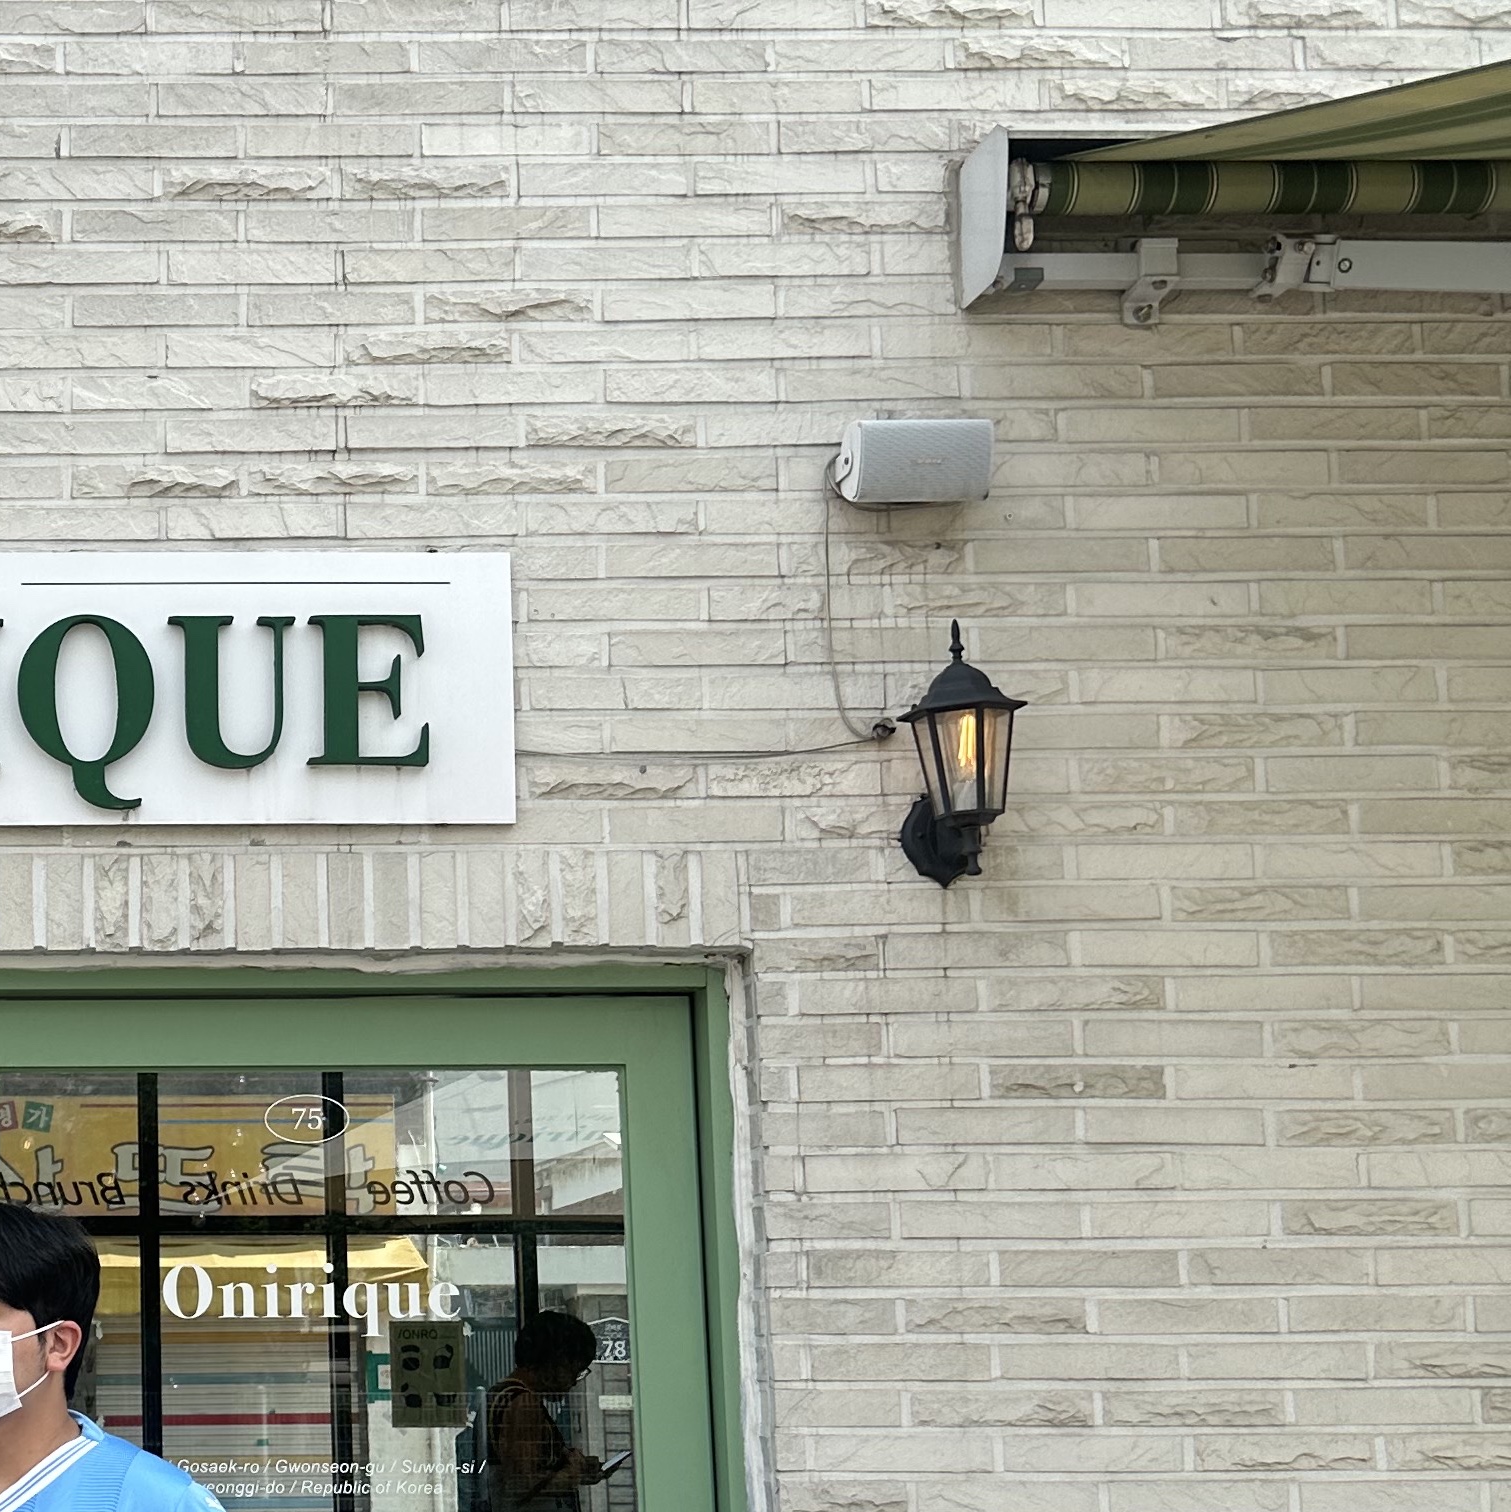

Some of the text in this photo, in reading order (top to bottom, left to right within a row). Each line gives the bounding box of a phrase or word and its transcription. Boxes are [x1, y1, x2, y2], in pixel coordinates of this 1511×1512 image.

[290, 1106, 325, 1131] 75
[161, 1261, 462, 1338] Onirique
[602, 1340, 627, 1359] 78
[176, 1459, 260, 1475] Gosaek-ro
[274, 1459, 385, 1478] Gwonseon-gu
[400, 1459, 475, 1475] Suwon-si
[300, 1480, 371, 1498] Republic
[374, 1479, 391, 1496] of
[396, 1480, 444, 1496] Korea
